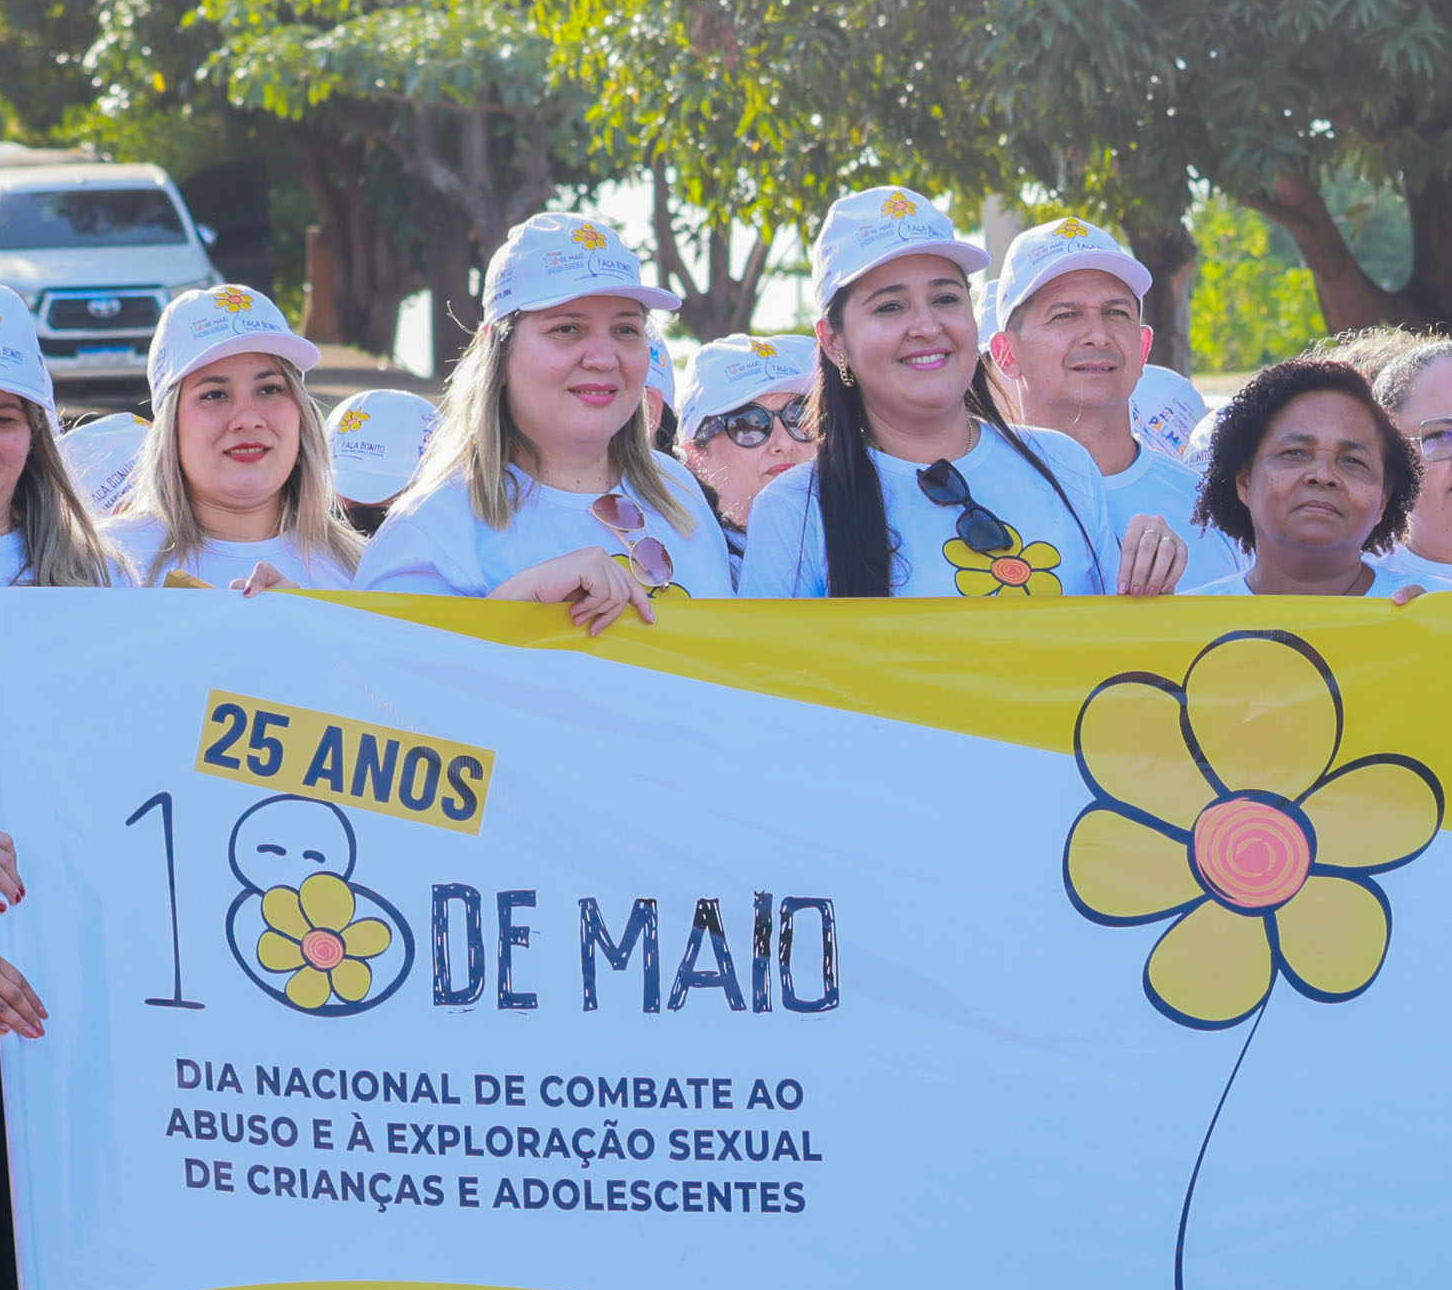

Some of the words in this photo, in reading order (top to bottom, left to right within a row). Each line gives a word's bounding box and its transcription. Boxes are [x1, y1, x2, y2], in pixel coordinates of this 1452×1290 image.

[203, 703, 291, 778] 25
[303, 724, 484, 822] ANOS
[432, 882, 541, 1012] DE
[579, 888, 841, 1014] MAIO
[175, 1058, 243, 1094] DIA
[255, 1064, 462, 1105] NACIONAL
[474, 1074, 526, 1107] DE
[539, 1075, 733, 1110] COMBATE
[747, 1078, 804, 1111] AO
[166, 1107, 298, 1147] ABUSO
[312, 1118, 334, 1150] E
[346, 1112, 375, 1153] À
[387, 1120, 656, 1169] EXPLORAÇÃO
[668, 1128, 823, 1162] SEXUAL
[185, 1157, 235, 1193] DE
[247, 1164, 445, 1213] CRIANÇAS
[459, 1176, 480, 1208] E
[492, 1178, 806, 1213] ADOLESCENTES
